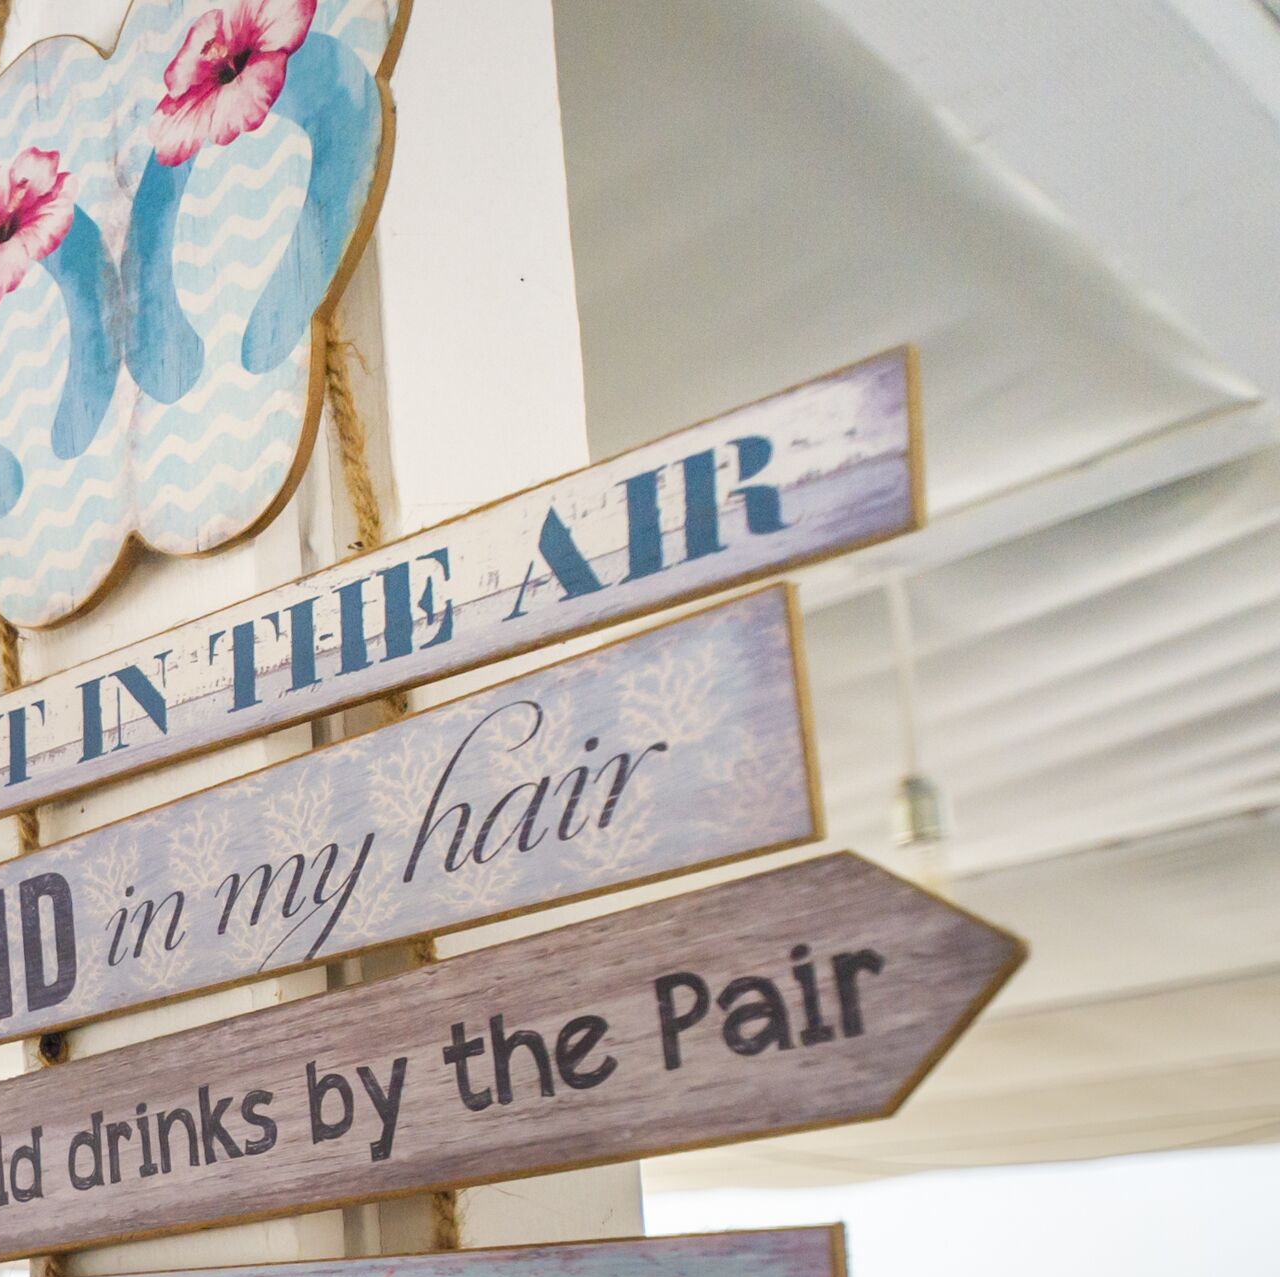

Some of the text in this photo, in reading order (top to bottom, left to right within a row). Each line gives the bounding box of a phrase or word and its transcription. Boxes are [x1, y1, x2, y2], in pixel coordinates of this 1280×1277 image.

[78, 648, 170, 764] IN
[210, 546, 456, 714] THE
[502, 434, 794, 622] AIR
[106, 884, 188, 968] in
[214, 830, 376, 972] my
[402, 698, 668, 884] hair
[66, 1084, 278, 1192] drinks
[308, 1056, 408, 1162] by
[442, 1010, 618, 1114] the
[652, 942, 886, 1072] Pair
